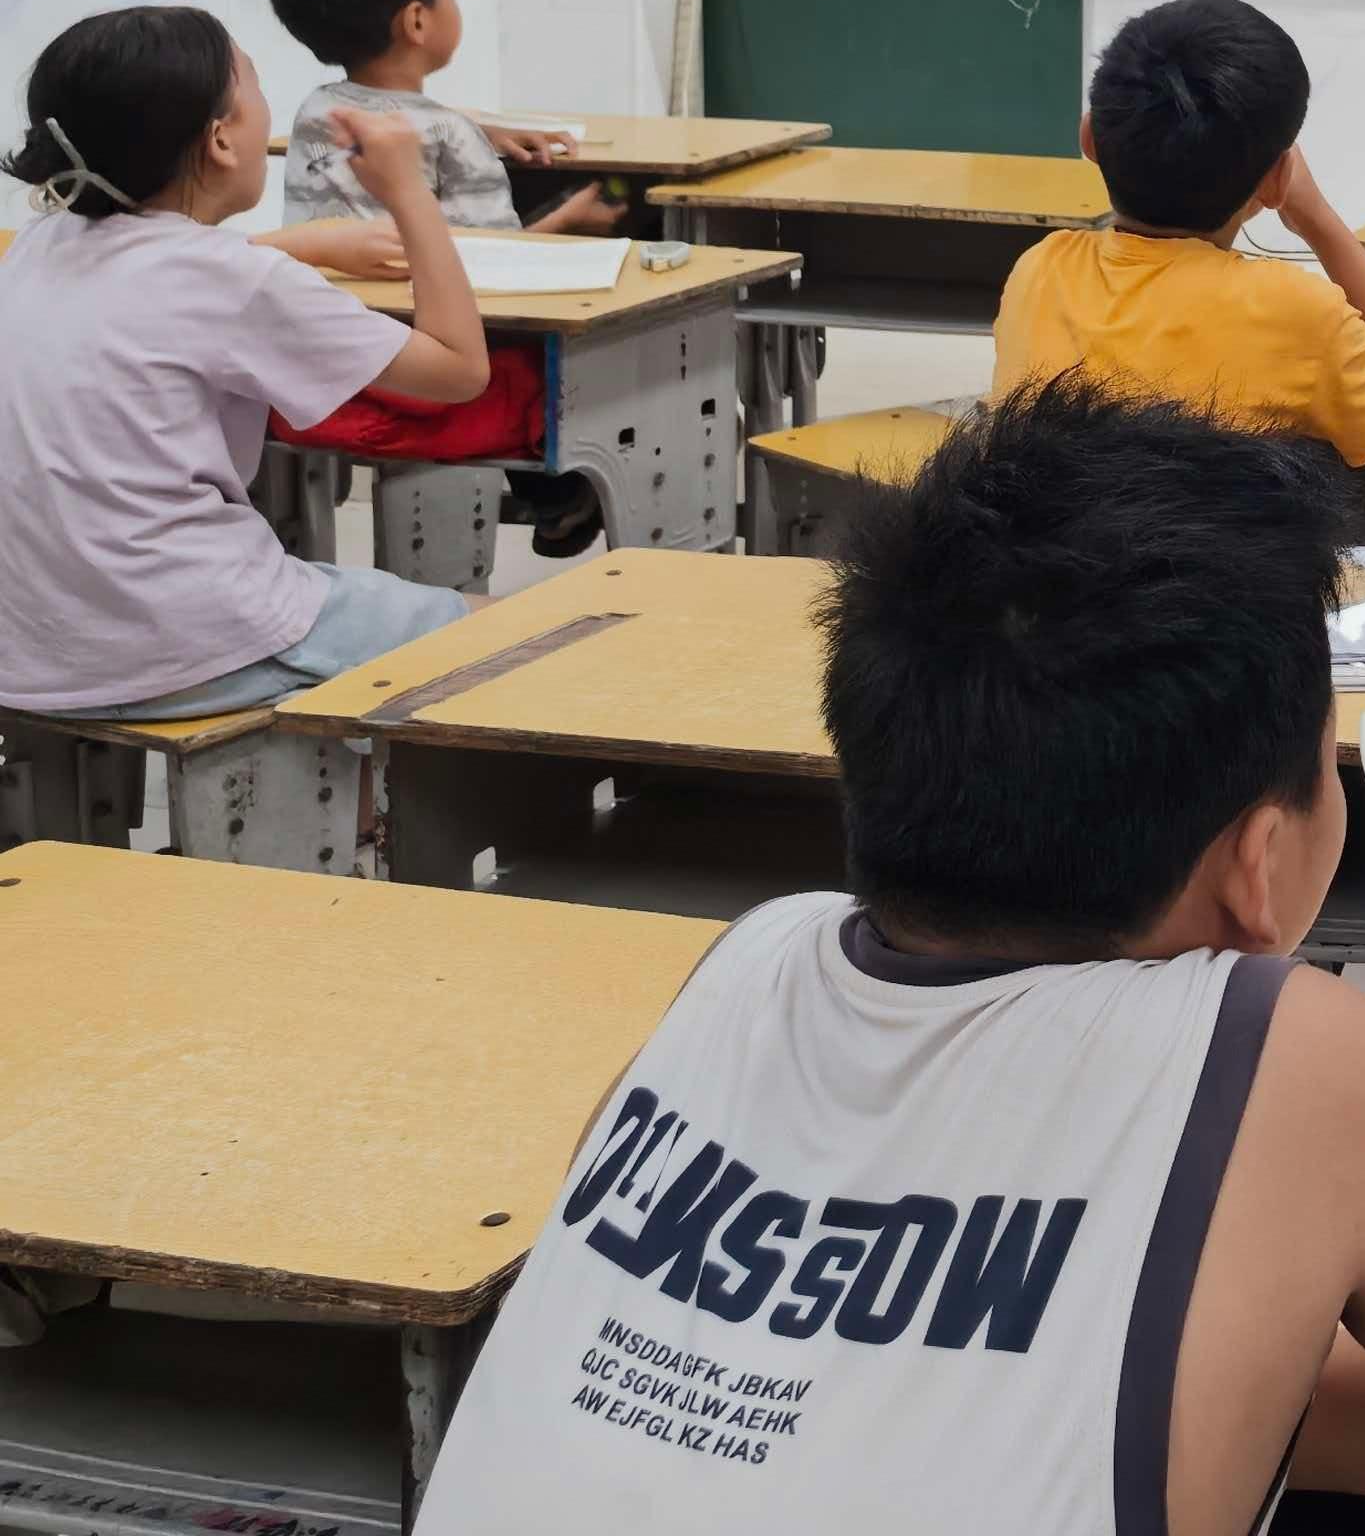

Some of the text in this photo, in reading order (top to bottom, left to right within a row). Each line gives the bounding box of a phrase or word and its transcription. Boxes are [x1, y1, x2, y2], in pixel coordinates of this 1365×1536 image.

[570, 1384, 770, 1465] AW EJFGL KZ HAS
[580, 1347, 620, 1381] QJC
[725, 1404, 803, 1436] AEHK
[727, 1372, 814, 1403] JBKAV
